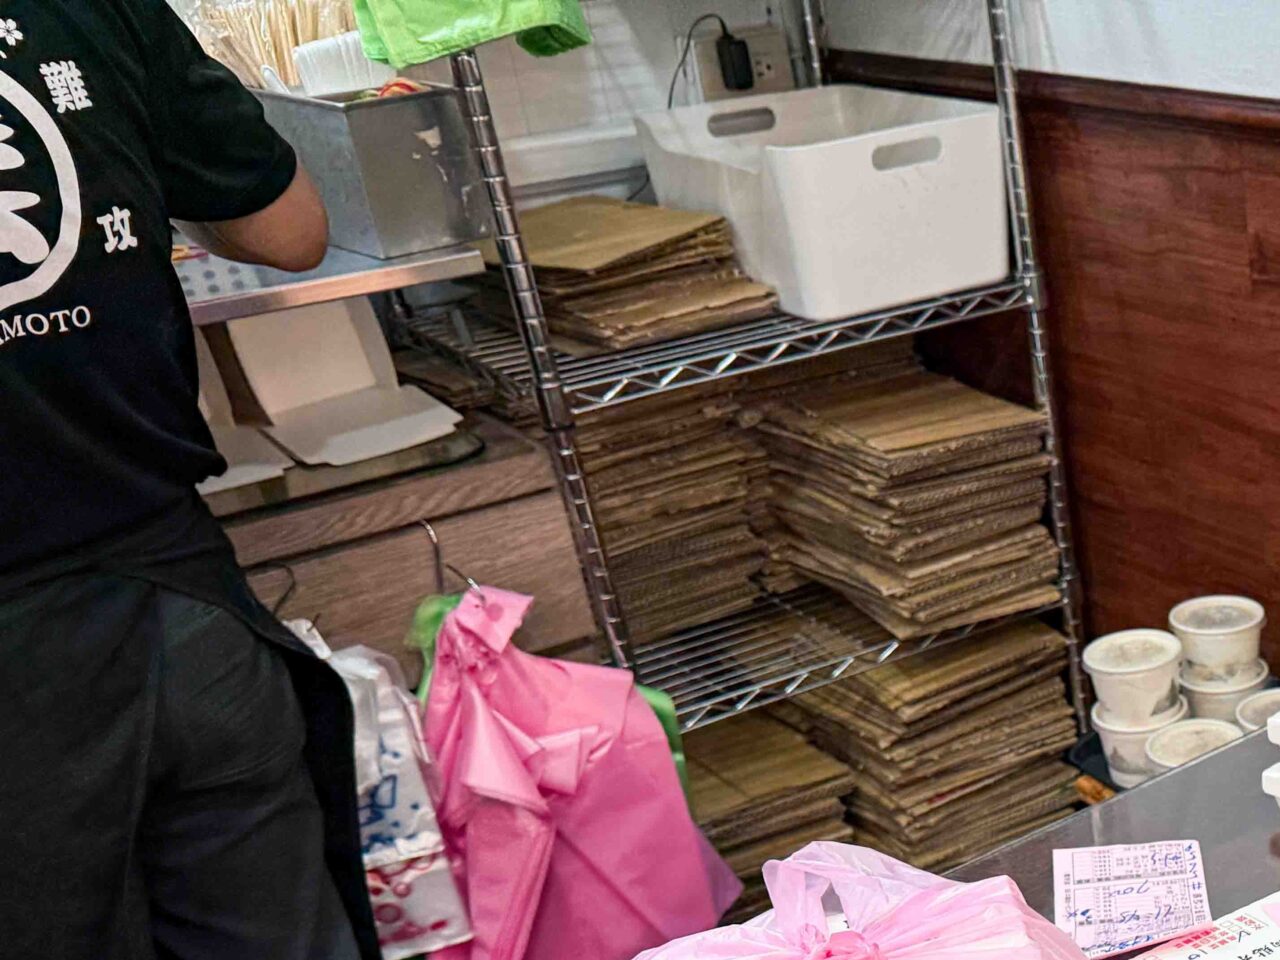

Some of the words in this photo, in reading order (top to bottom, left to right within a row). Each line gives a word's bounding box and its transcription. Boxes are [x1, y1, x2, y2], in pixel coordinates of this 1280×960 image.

[39, 60, 93, 114] 難
[96, 206, 138, 254] 攻
[0, 305, 92, 347] MOTO
